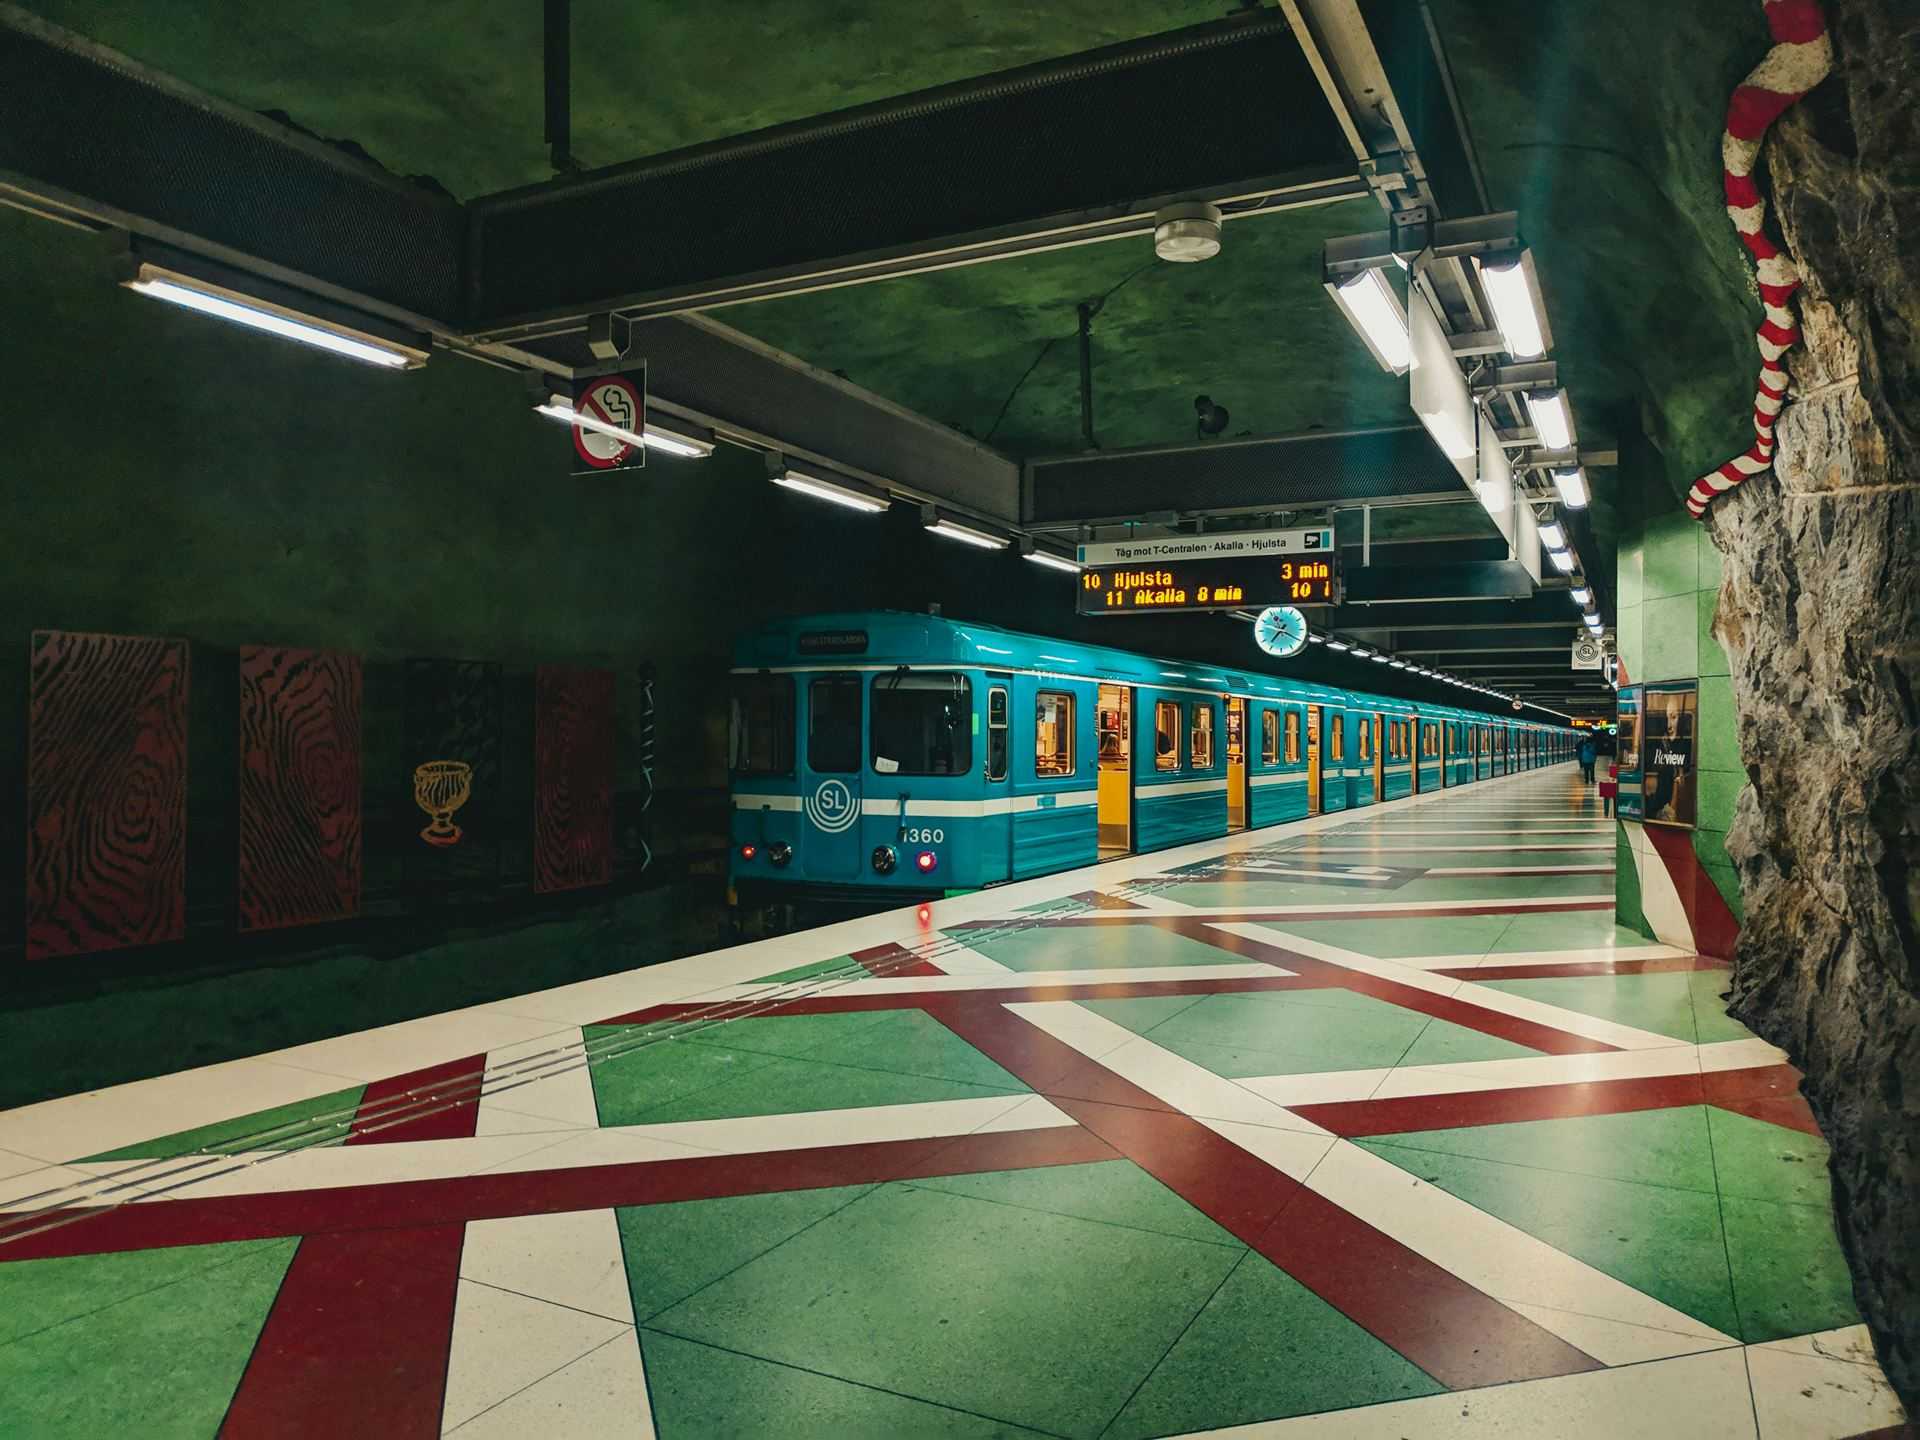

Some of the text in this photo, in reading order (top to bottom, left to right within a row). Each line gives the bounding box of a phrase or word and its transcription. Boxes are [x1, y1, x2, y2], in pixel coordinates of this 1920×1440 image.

[1115, 539, 1287, 558] Tåg mot T-Centralen Akalla Hjulsta
[1083, 562, 1328, 589] 10 Hjulsta 3 min
[1106, 590, 1123, 605] 11
[1135, 588, 1185, 604] Akalla
[1197, 587, 1208, 601] 8
[1214, 586, 1242, 601] min
[1291, 582, 1311, 598] 10
[1582, 647, 1592, 655] SL
[1654, 748, 1686, 766] Review
[822, 789, 845, 810] SL
[901, 828, 944, 844] 1360
